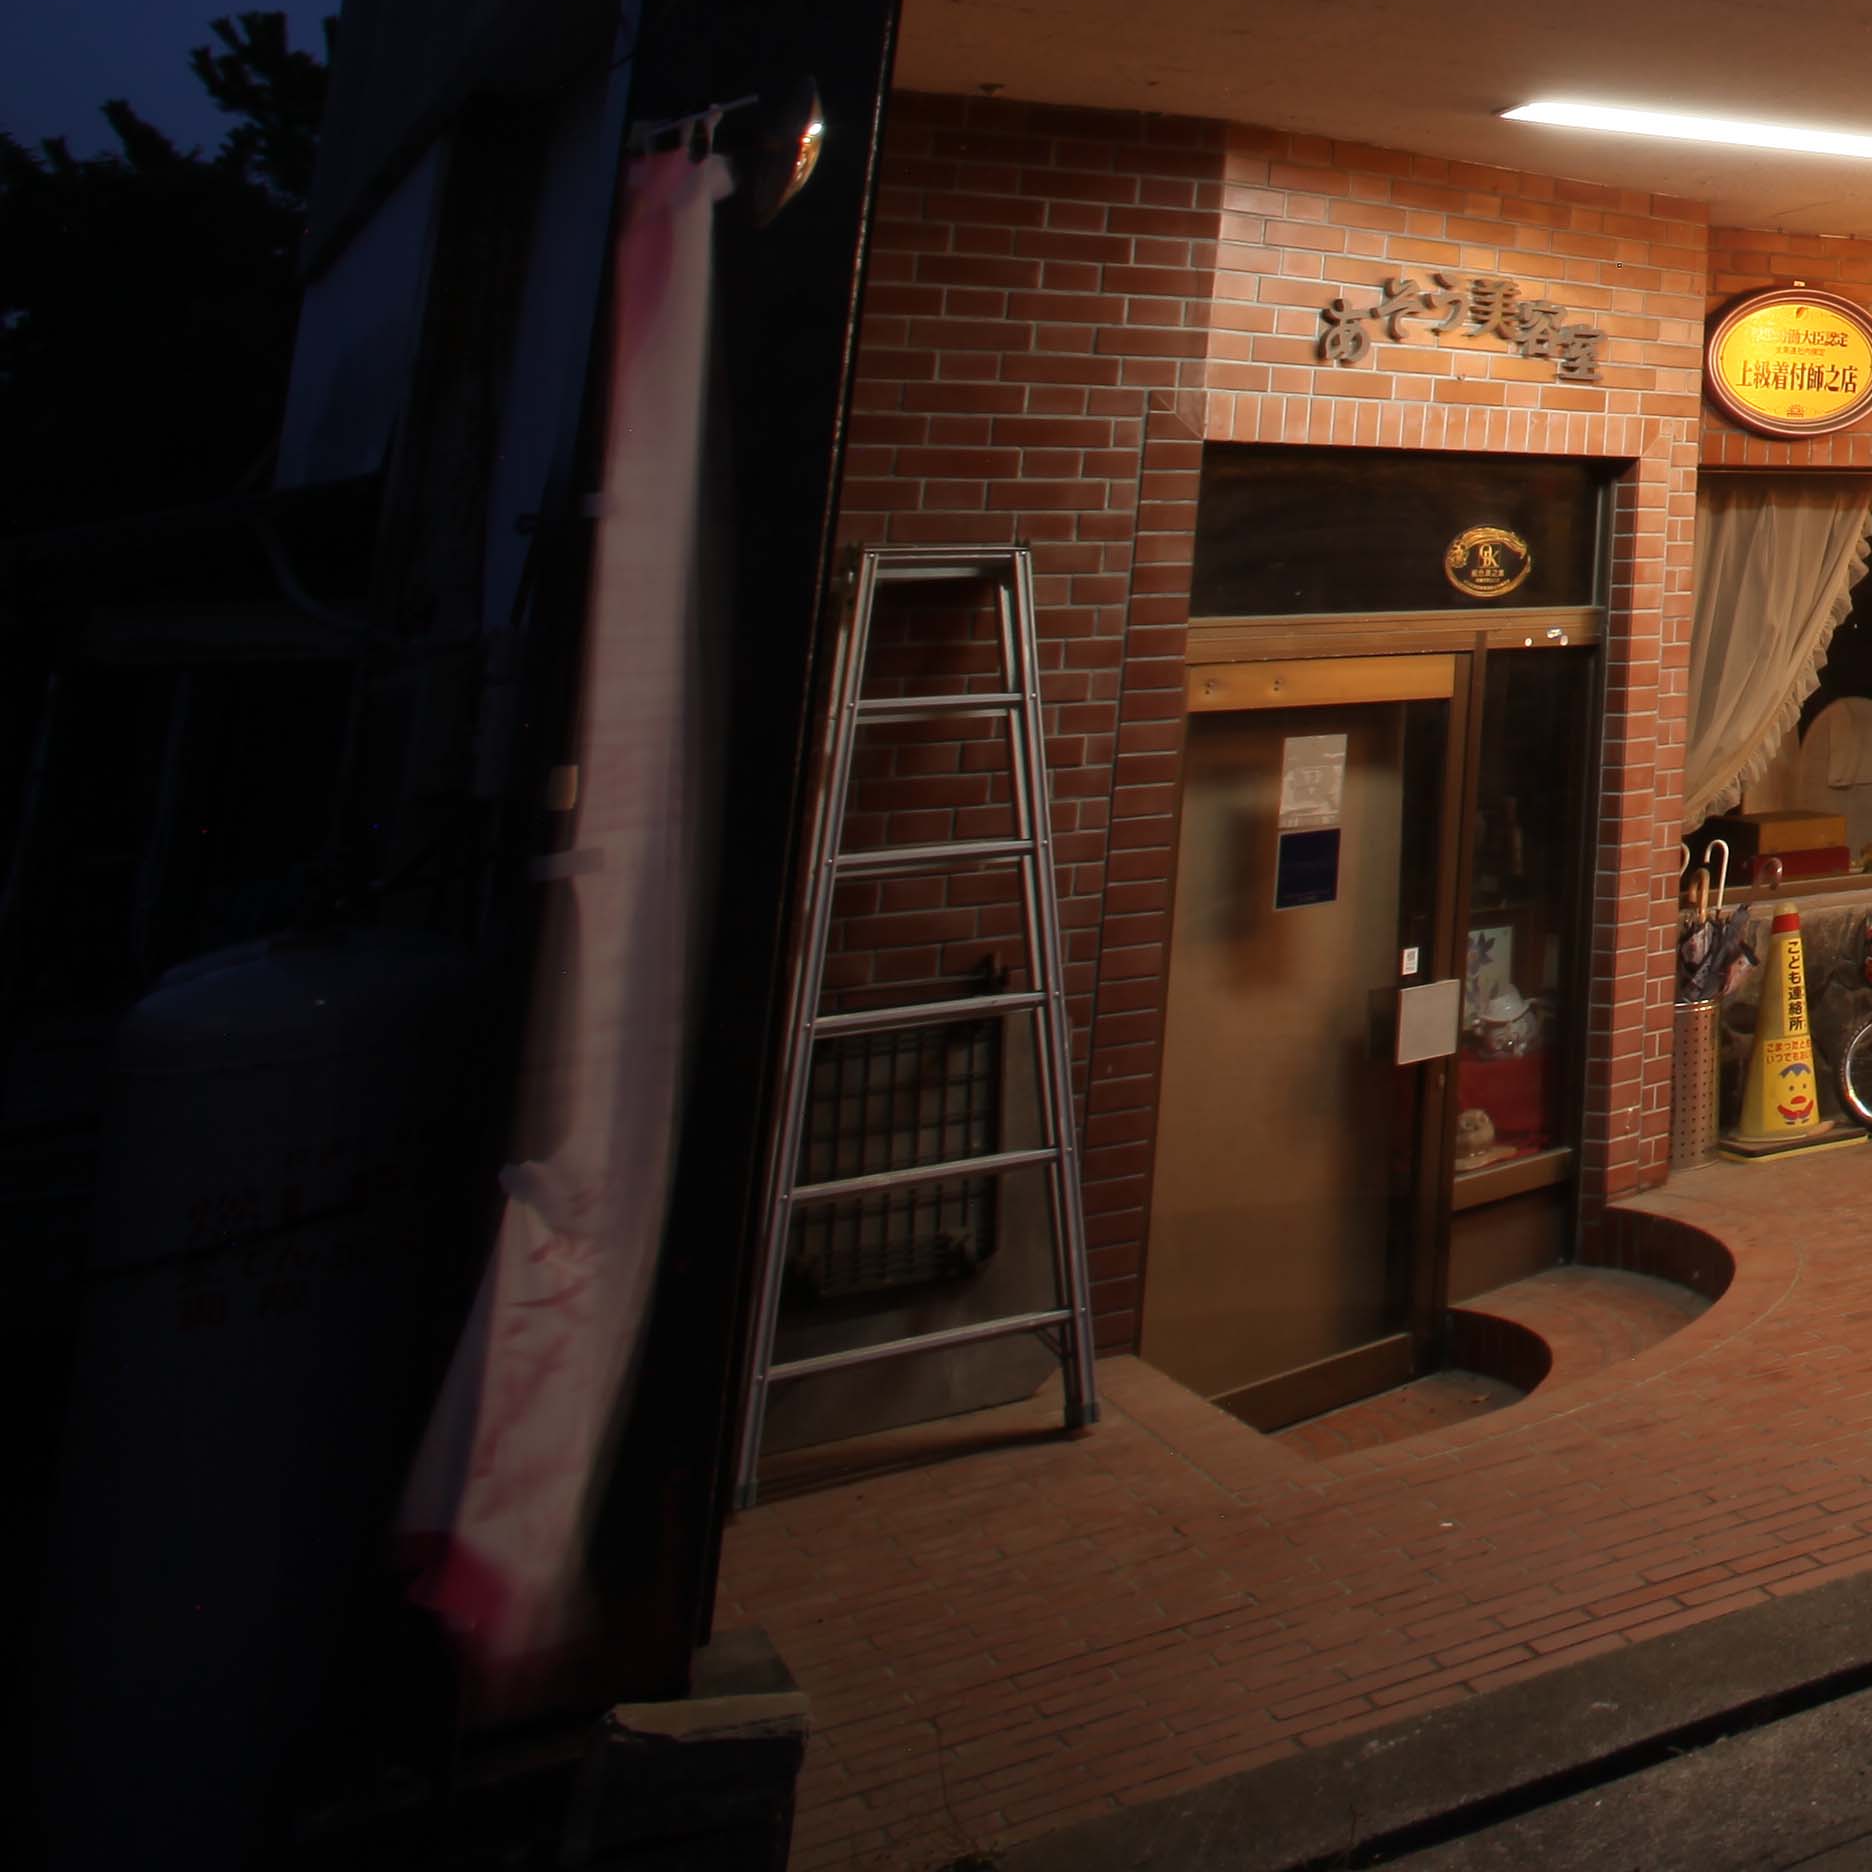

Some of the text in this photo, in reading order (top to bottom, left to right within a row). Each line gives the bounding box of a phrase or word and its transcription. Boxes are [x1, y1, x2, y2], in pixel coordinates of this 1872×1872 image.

[1314, 272, 1606, 381] あそう美容室
[1736, 359, 1858, 394] 上級着付師之店
[1788, 941, 1804, 1032] こども連絡所
